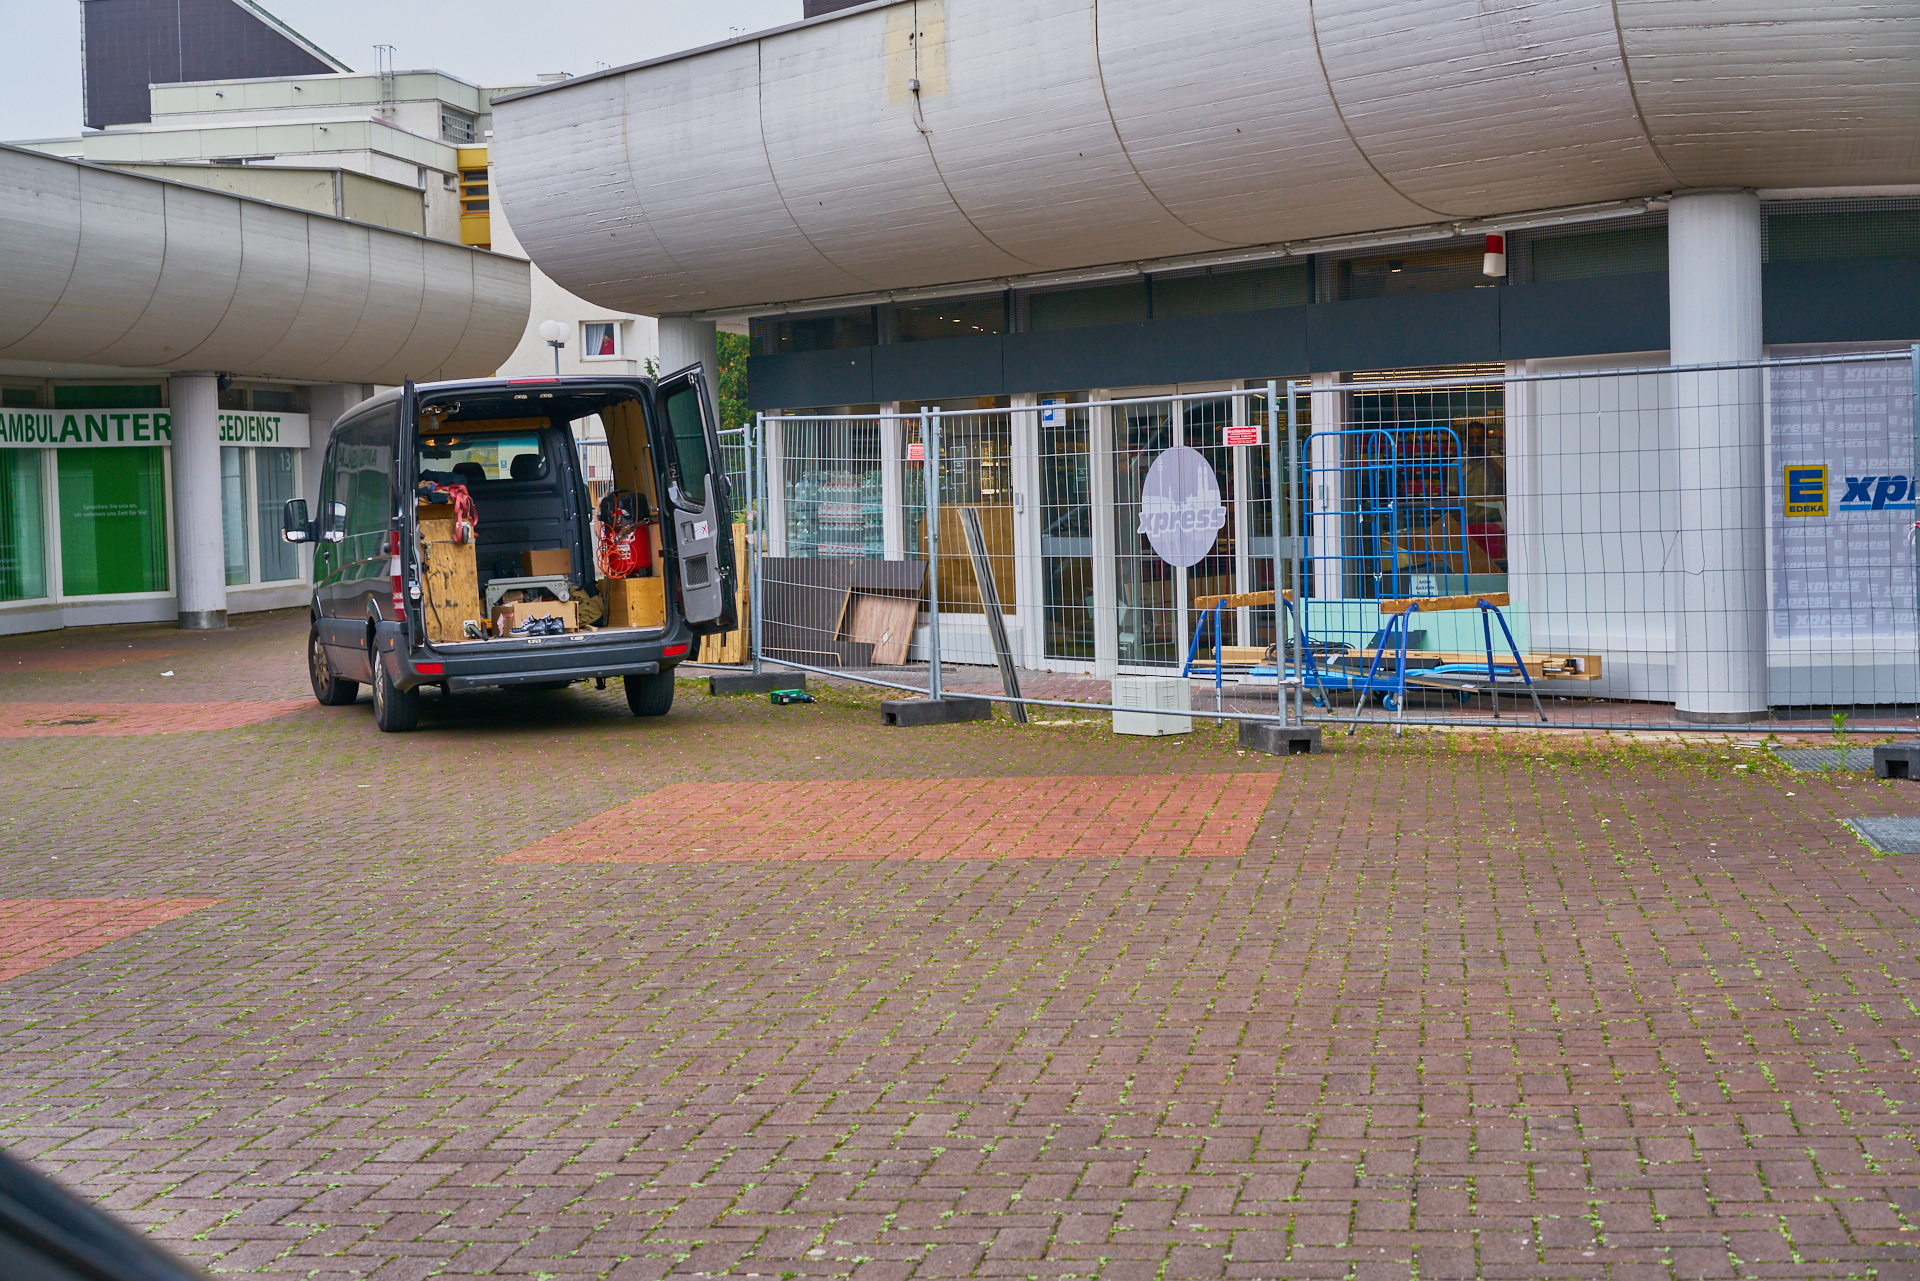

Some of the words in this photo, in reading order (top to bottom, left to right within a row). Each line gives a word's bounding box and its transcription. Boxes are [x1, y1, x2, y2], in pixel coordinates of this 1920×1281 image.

[0, 413, 171, 443] AMBULANTER
[1279, 413, 1287, 431] KEFIR
[280, 452, 292, 471] 13
[1789, 470, 1823, 503] E
[1138, 506, 1227, 536] xpress
[1795, 613, 1867, 628] xpress
